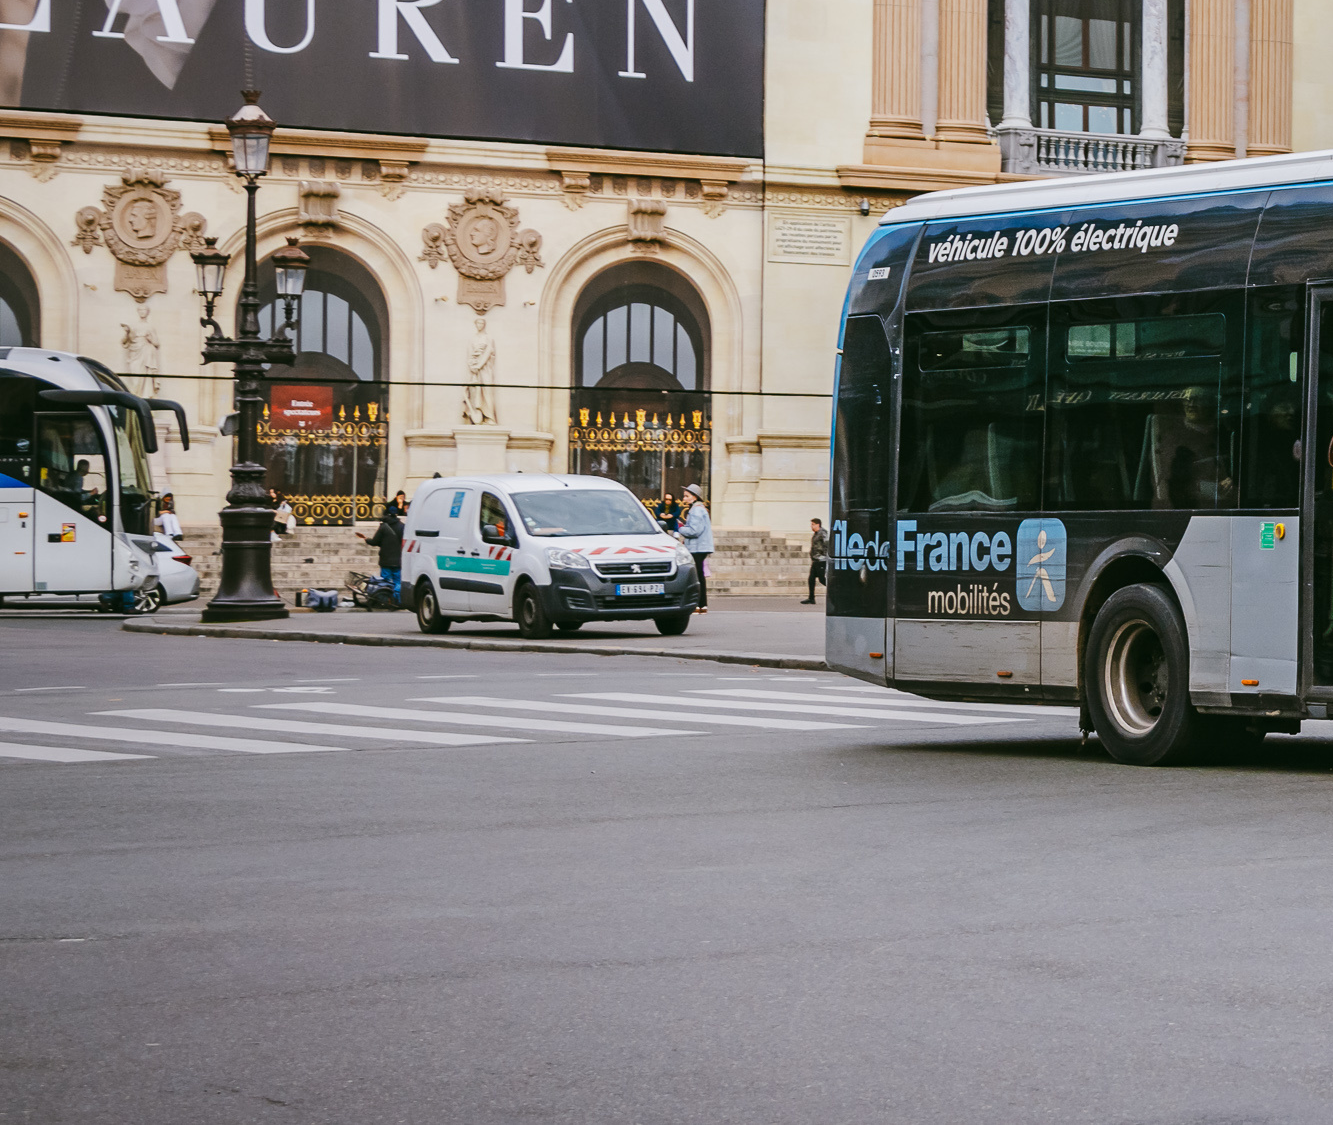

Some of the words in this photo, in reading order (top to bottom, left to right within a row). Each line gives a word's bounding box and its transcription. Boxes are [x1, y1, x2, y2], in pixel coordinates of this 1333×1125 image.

[928, 230, 1008, 263] véhicule
[1012, 226, 1070, 256] 100%
[1070, 220, 1180, 254] électrique
[928, 582, 1011, 616] mobilités
